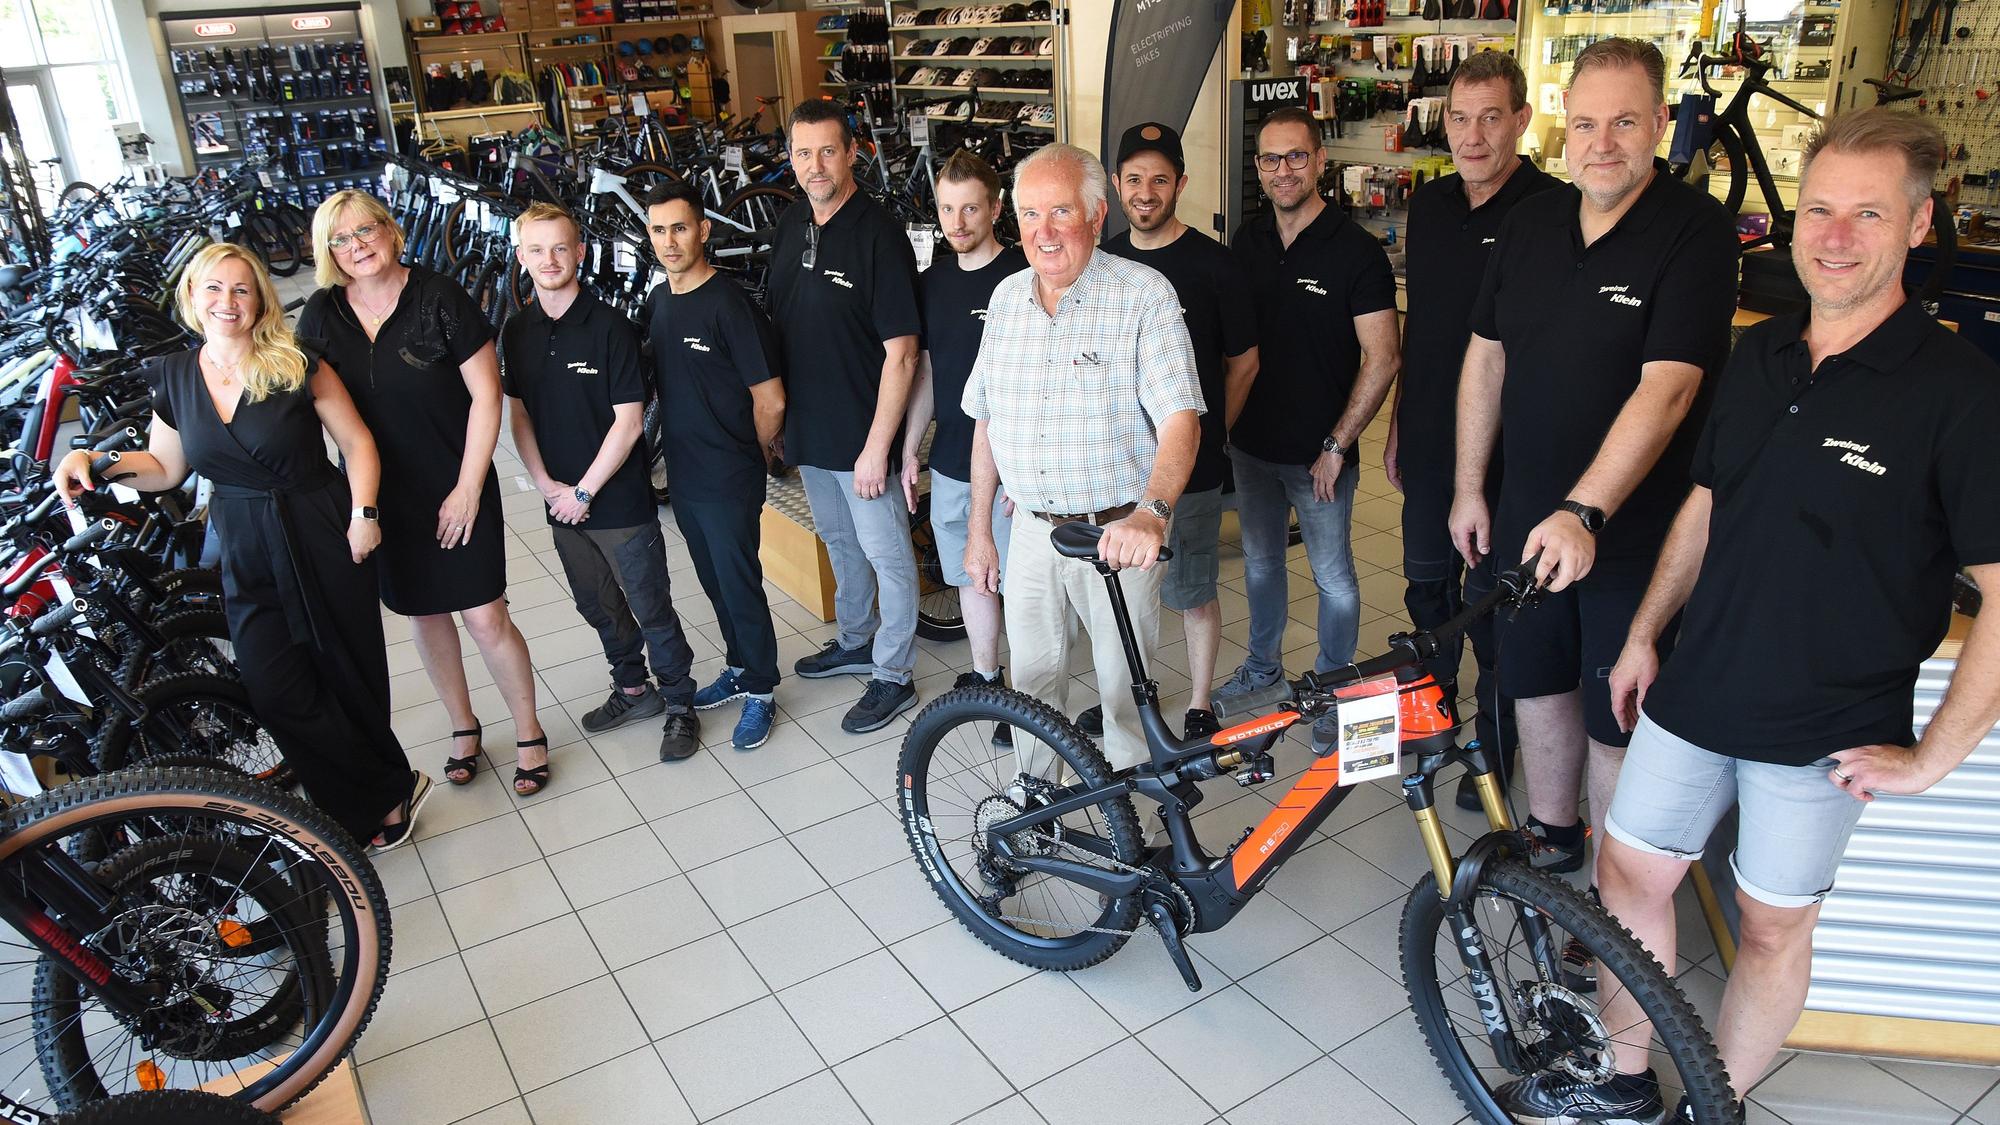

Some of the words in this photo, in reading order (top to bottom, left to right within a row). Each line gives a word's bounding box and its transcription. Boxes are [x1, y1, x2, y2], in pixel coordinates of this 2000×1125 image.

[1130, 16, 1192, 55] ELECTRIFYING
[1135, 48, 1160, 68] BIKES
[1251, 81, 1299, 102] uvex
[831, 276, 853, 289] Klein
[1305, 284, 1327, 296] Klein
[1598, 285, 1630, 294] Zweirad
[1609, 293, 1642, 307] Klein
[576, 367, 598, 375] Klein
[1821, 437, 1870, 453] Zweirad
[1839, 452, 1887, 475] Klein
[1227, 720, 1285, 742] ROTWILD
[904, 788, 943, 883] SCHWALBE
[1471, 979, 1508, 1035] FOX
